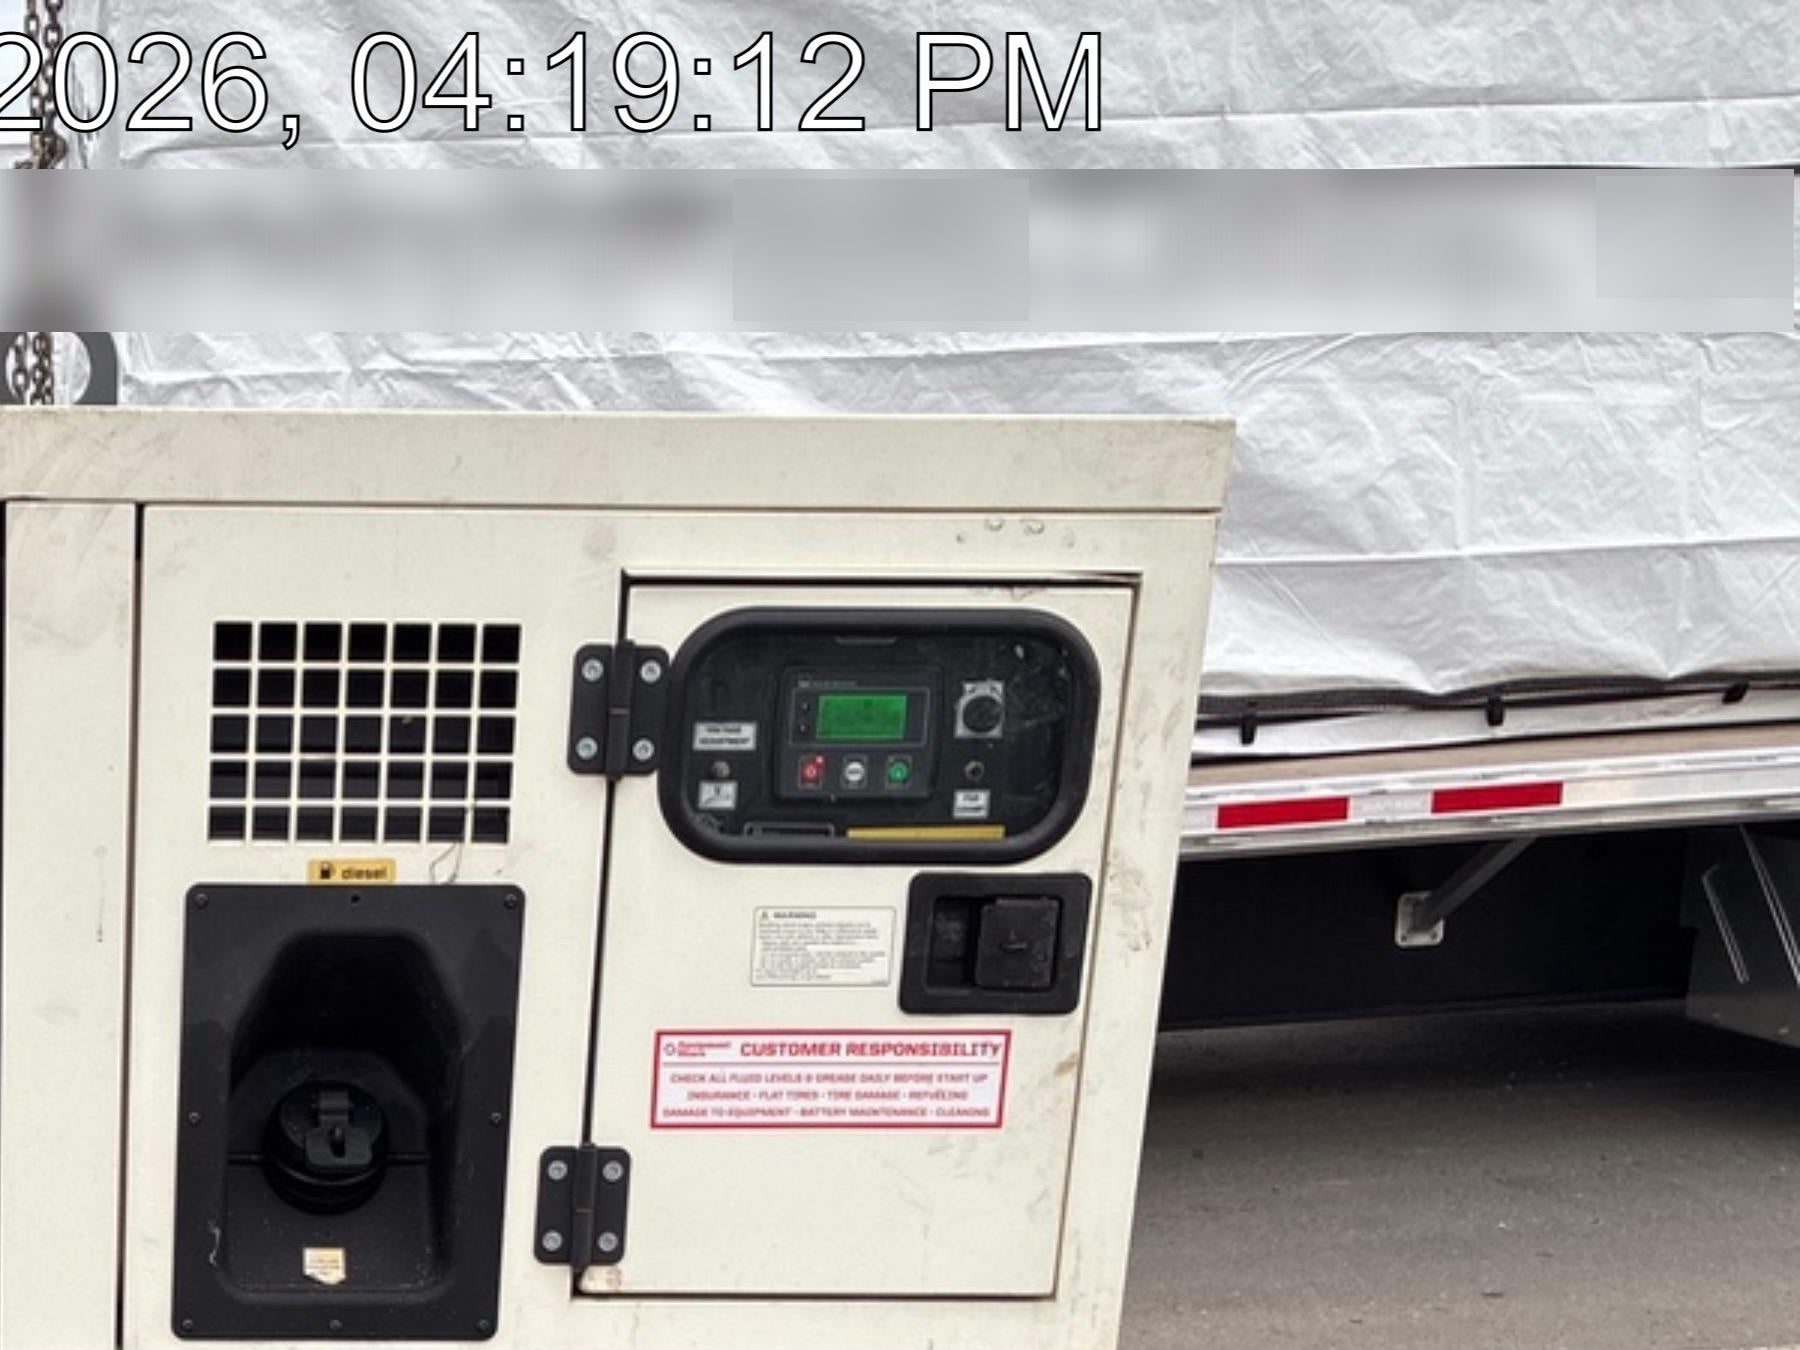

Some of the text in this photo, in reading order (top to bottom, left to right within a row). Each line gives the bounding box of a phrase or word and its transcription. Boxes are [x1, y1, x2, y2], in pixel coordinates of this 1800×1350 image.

[341, 864, 388, 880] diesel
[740, 1042, 1001, 1057] CUSTOMER RESPONSIBILITY
[670, 1073, 705, 1083] CHECK
[708, 1073, 727, 1083] ALL
[972, 1073, 989, 1083] UP
